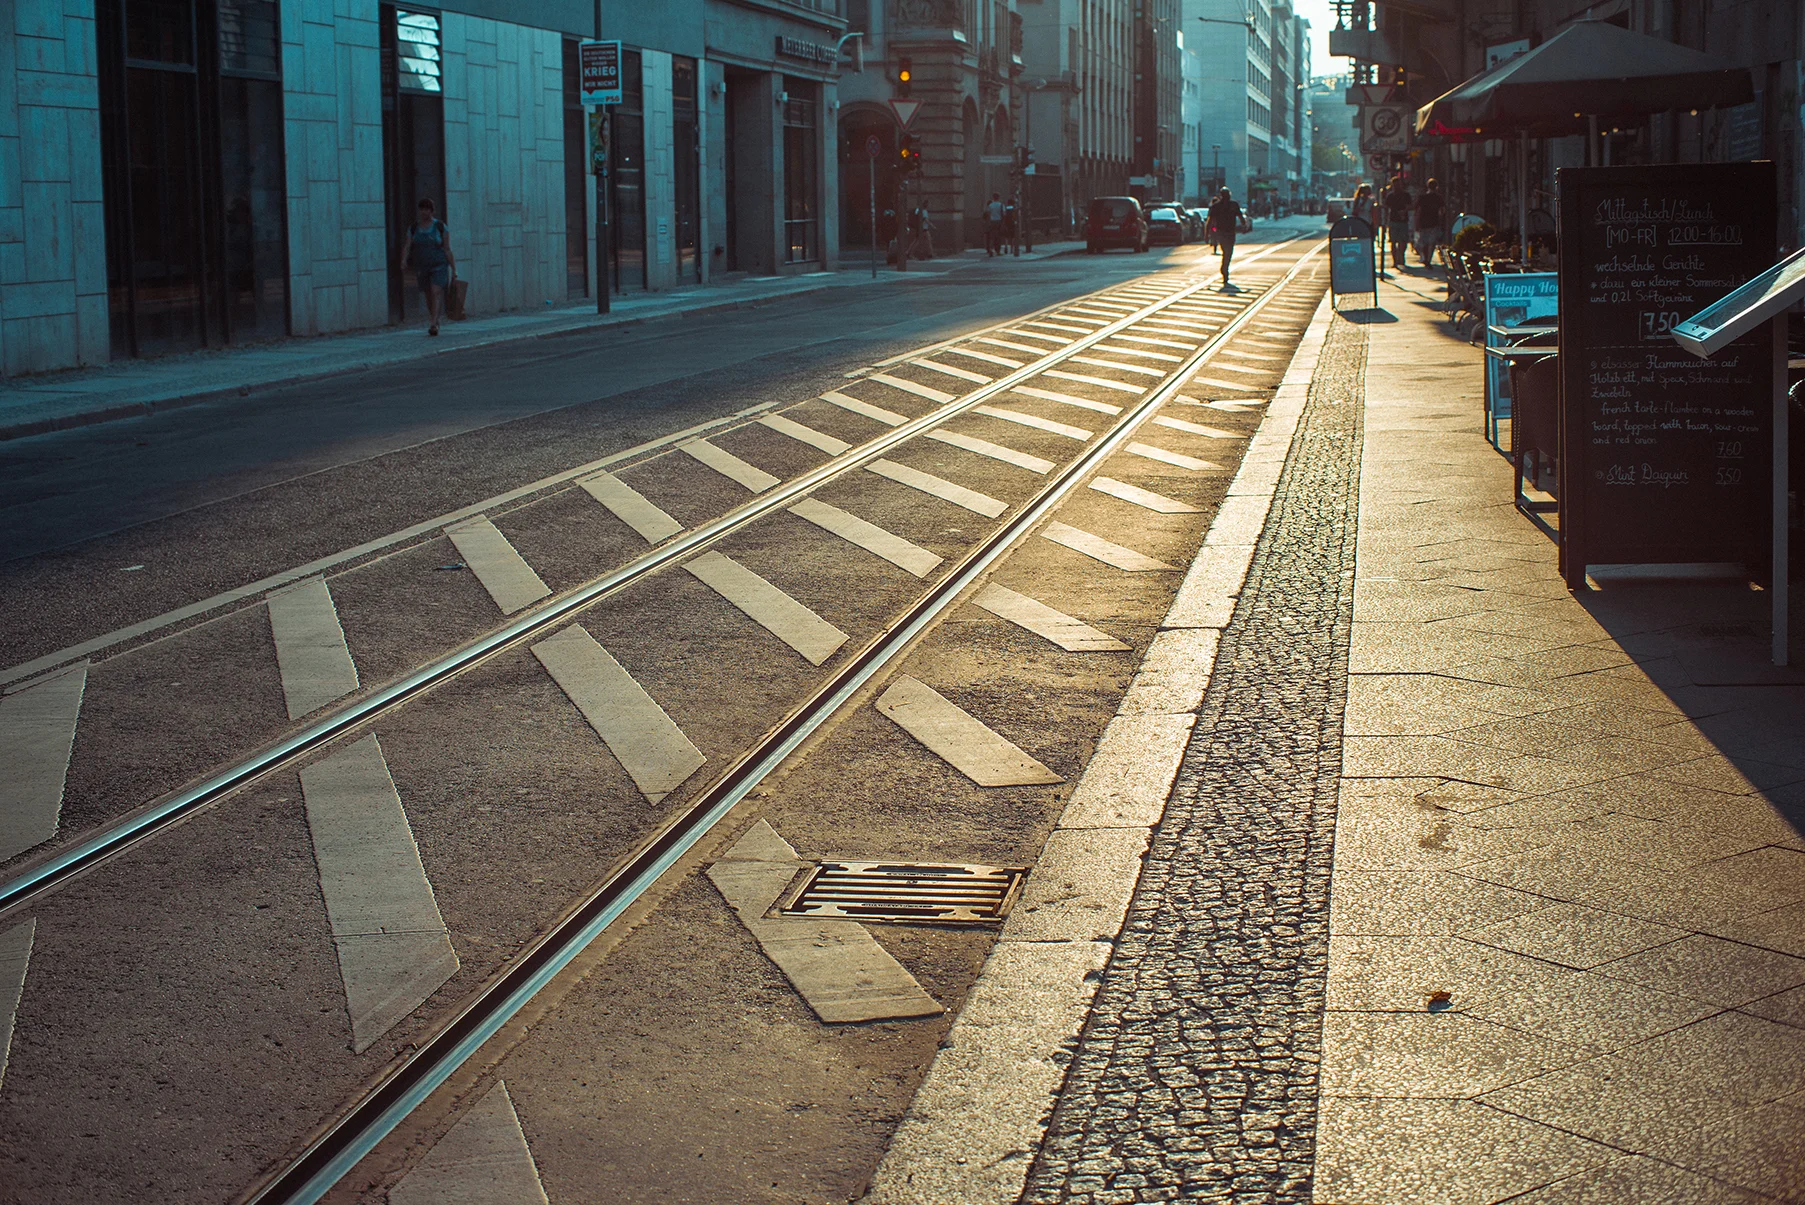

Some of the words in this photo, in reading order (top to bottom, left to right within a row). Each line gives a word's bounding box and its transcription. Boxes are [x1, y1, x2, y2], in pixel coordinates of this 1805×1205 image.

[584, 66, 617, 77] KRIEG
[1668, 225, 1741, 243] 12:00-16:00
[1594, 254, 1655, 272] wechselnde
[1662, 254, 1705, 271] Gerichte
[1600, 276, 1624, 289] dazu
[1631, 279, 1646, 287] ein
[1648, 274, 1681, 288] kleiner
[1494, 282, 1536, 297] Happy
[1590, 293, 1607, 303] und
[1645, 353, 1718, 370] Flammkuchen
[1721, 356, 1740, 368] auf
[1641, 371, 1656, 383] mit
[1600, 402, 1632, 415] french
[1724, 406, 1754, 416] wooden
[1591, 420, 1622, 433] board,
[1624, 419, 1657, 436] topped
[1660, 418, 1683, 430] with
[1592, 435, 1611, 445] and
[1616, 434, 1630, 444] red
[1634, 435, 1658, 445] onion
[1606, 463, 1636, 481] Mint
[1640, 462, 1689, 488] Daiquiri
